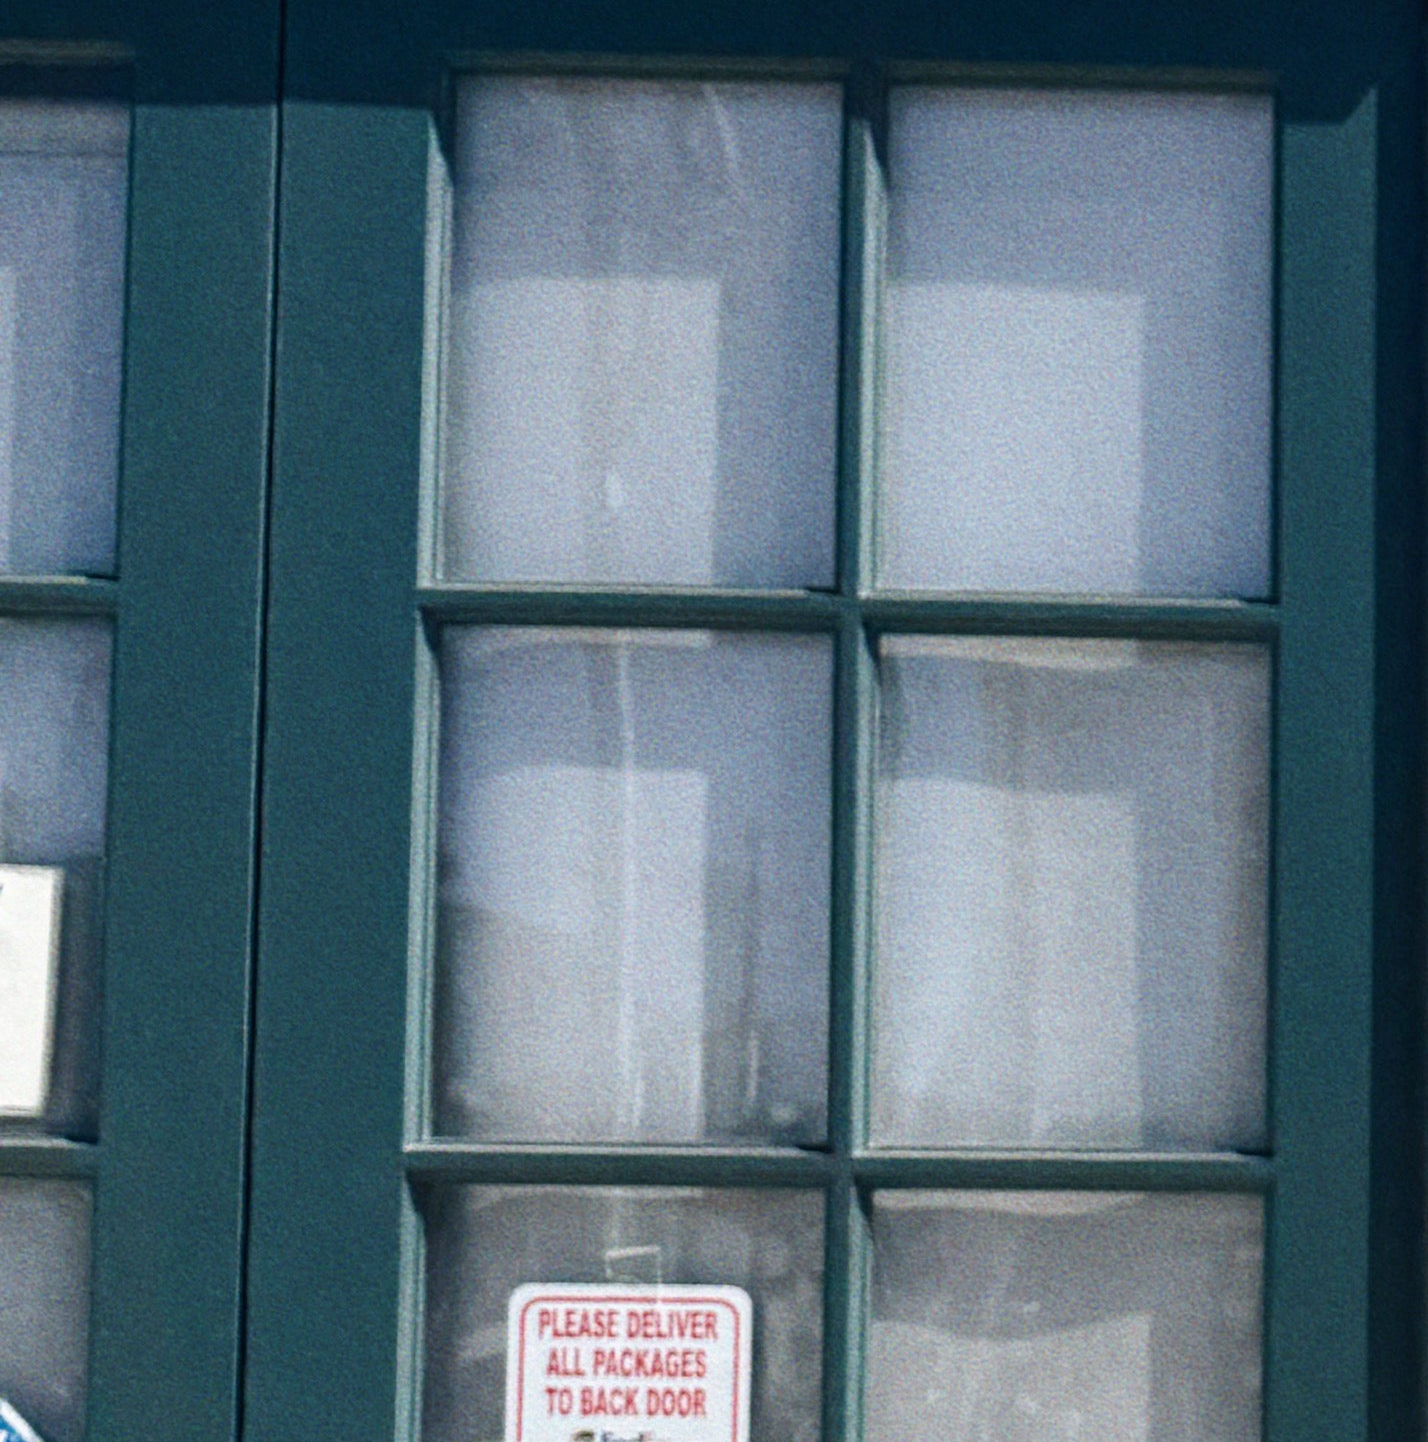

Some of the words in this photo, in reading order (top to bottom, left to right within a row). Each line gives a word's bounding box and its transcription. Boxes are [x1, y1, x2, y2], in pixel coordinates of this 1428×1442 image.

[538, 1308, 619, 1339] PLEASE
[627, 1310, 718, 1340] DELIVER
[546, 1348, 585, 1377] ALL
[593, 1348, 707, 1378] PACKAGES
[545, 1387, 573, 1415] TO
[580, 1387, 639, 1416] BACK
[646, 1388, 707, 1417] DOOR
